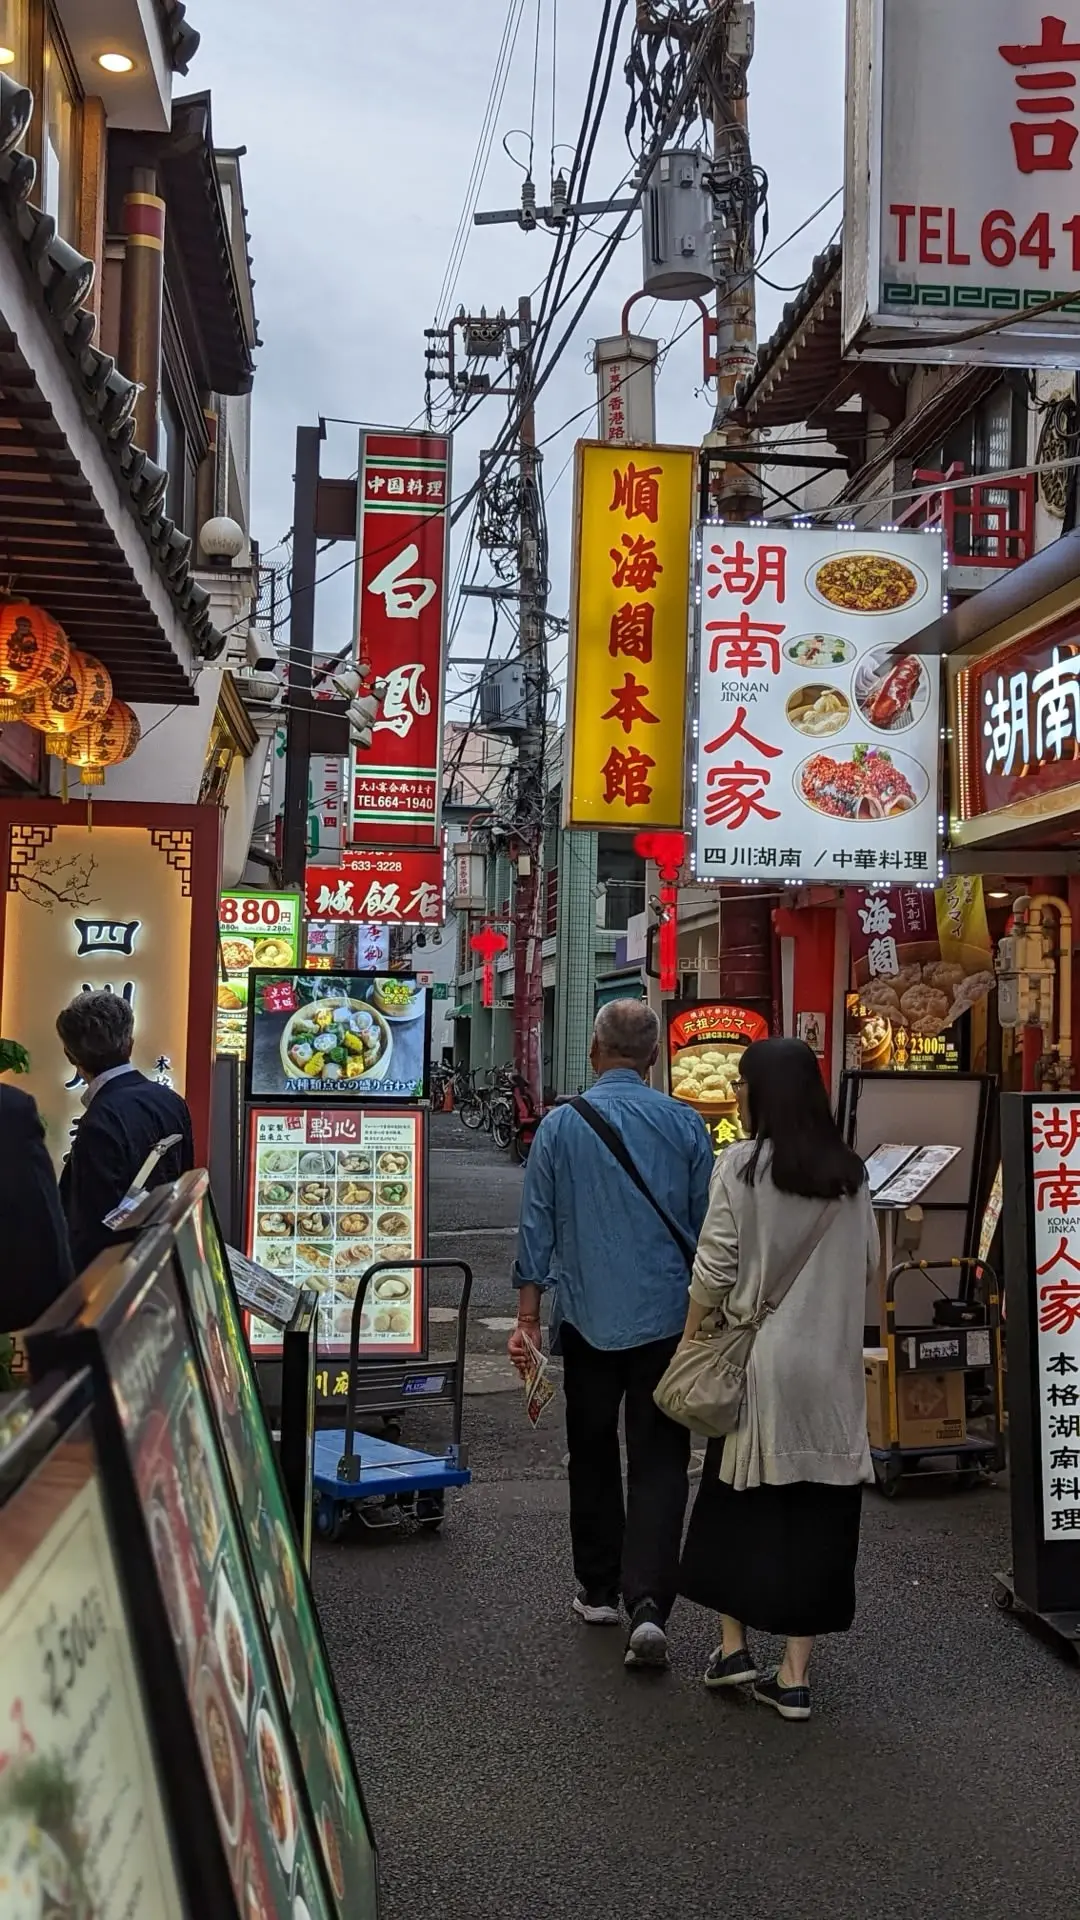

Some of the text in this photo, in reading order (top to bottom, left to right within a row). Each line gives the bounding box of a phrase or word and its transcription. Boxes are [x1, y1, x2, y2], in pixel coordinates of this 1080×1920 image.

[890, 204, 970, 266] TEL
[368, 475, 443, 497] 中国料理
[720, 692, 758, 703] JINKA
[721, 681, 769, 693] KONAN
[359, 780, 432, 794] 大小宴会承ります
[305, 880, 440, 918] 城飯店
[946, 876, 962, 937] シウマイ
[858, 889, 899, 977] 海閣
[683, 1016, 757, 1033] 元祖シウマイ
[310, 1117, 357, 1138] 點心
[1048, 1225, 1076, 1233] JINKA
[1046, 1352, 1080, 1531] 本格湖南料理
